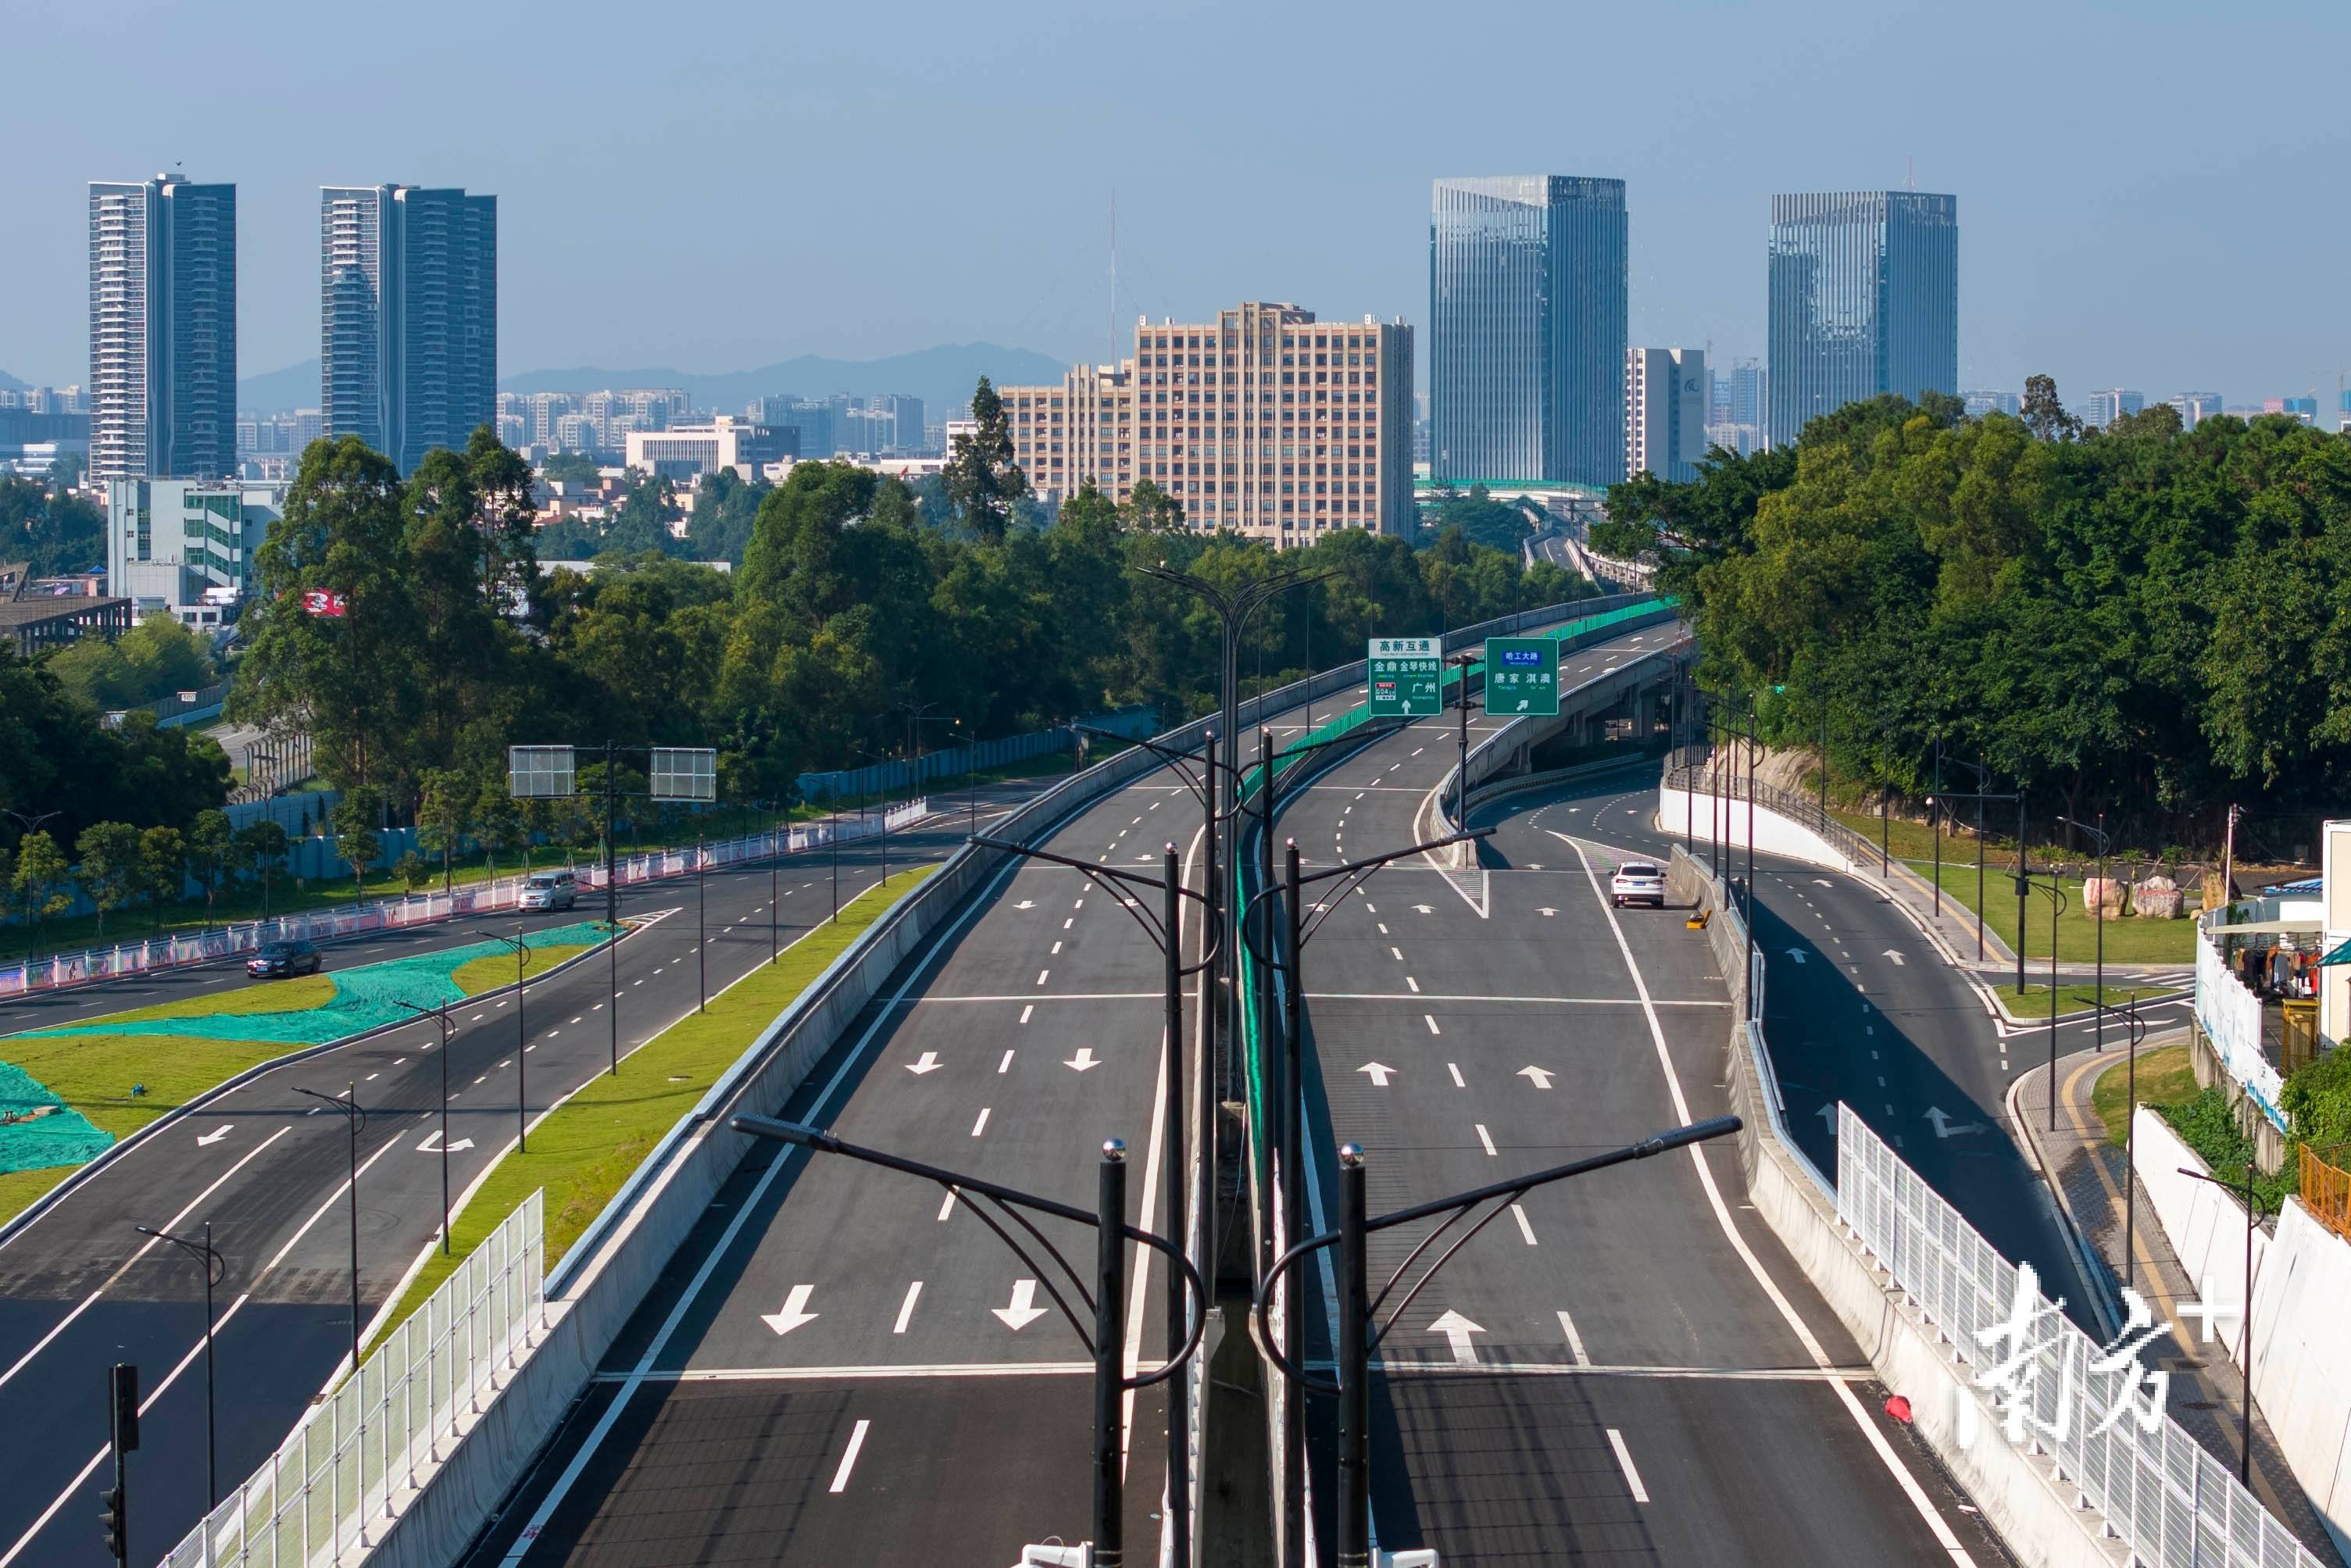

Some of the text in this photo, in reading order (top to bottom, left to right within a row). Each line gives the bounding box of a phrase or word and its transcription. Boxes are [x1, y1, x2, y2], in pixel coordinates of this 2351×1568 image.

[1380, 641, 1431, 652] 高新互通
[1506, 652, 1538, 661] 哈工大路
[1374, 661, 1437, 672] 金鼎 金琴快线
[1494, 673, 1550, 684] 唐家 淇澳
[1412, 682, 1435, 693] 广州
